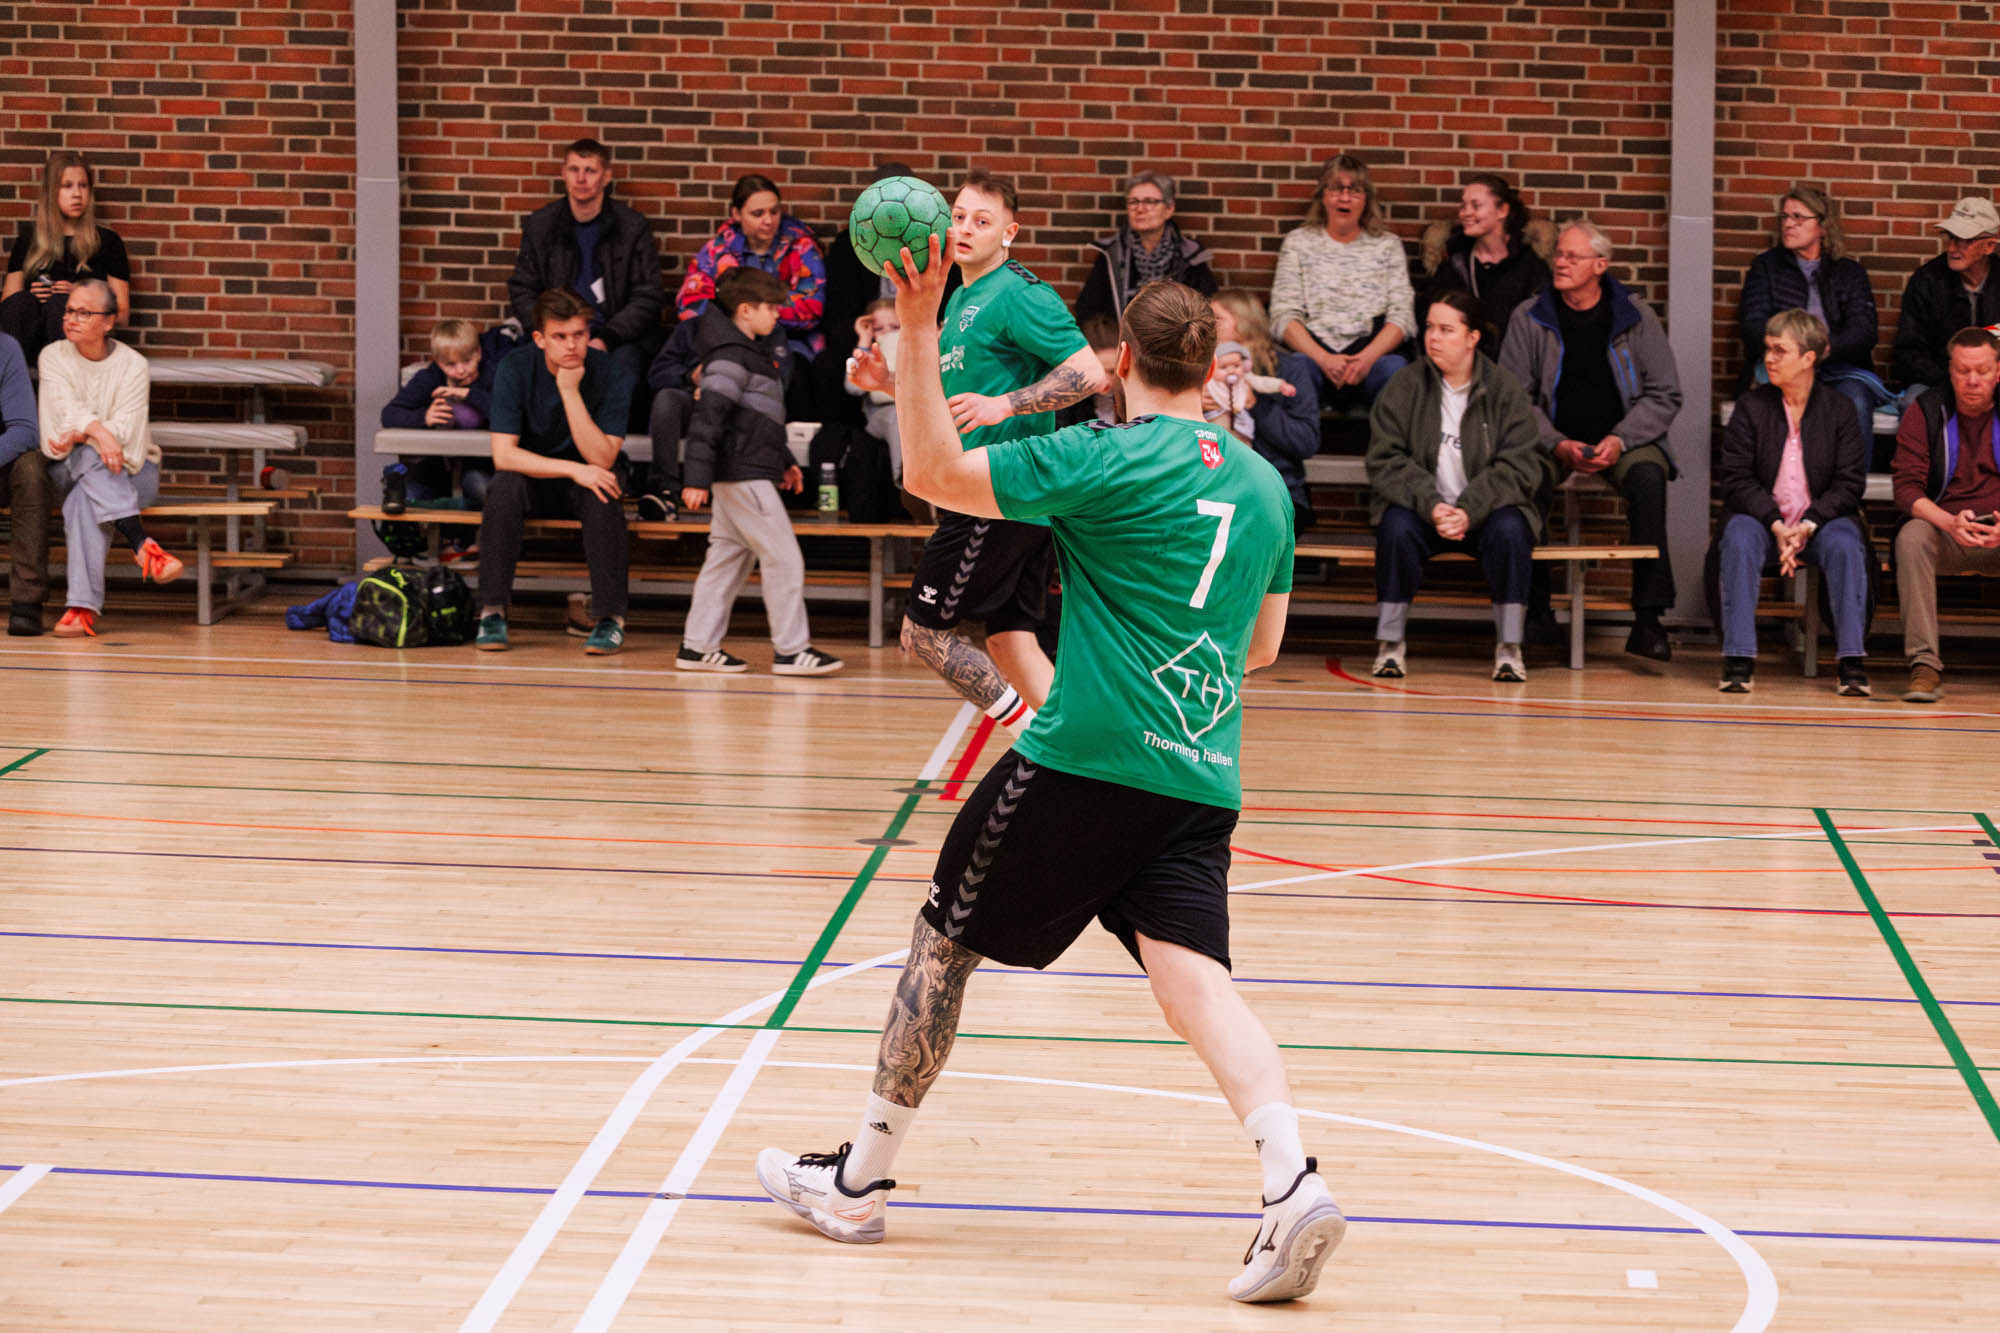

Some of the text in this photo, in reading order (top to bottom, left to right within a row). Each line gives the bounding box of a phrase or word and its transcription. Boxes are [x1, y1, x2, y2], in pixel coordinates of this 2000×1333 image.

[1202, 444, 1220, 462] 24
[1189, 499, 1236, 609] 7
[1169, 664, 1224, 723] TH
[1143, 731, 1233, 767] Thorning hallen
